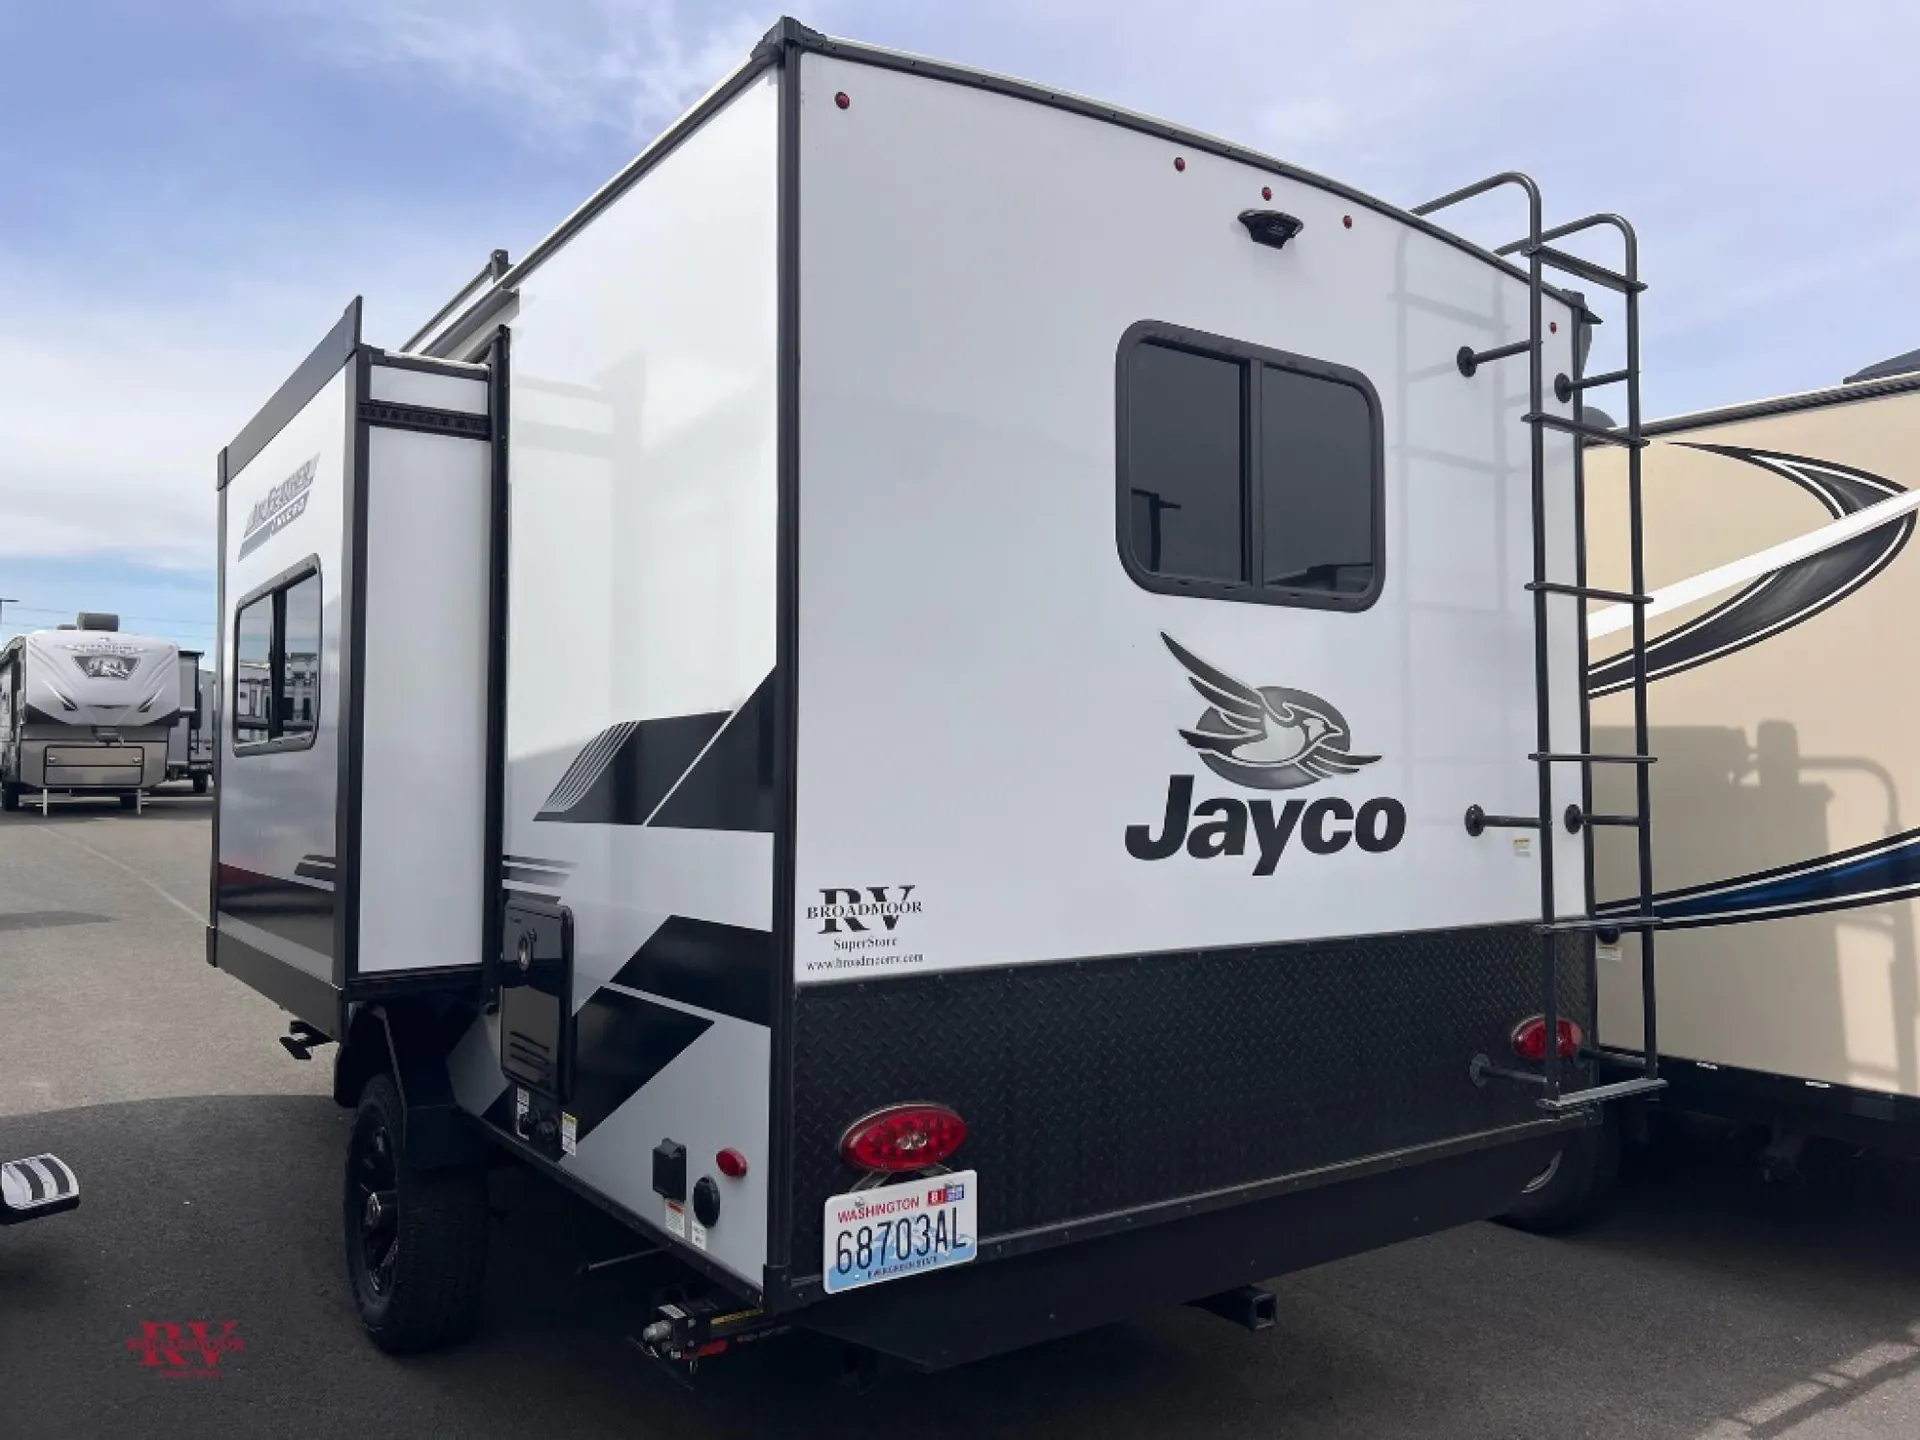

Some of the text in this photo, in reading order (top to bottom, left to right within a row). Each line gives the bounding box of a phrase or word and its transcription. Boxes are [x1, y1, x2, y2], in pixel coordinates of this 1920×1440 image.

[1125, 774, 1406, 876] Jayco
[806, 901, 922, 919] BROADMOOR
[817, 885, 915, 934] RV
[834, 936, 897, 953] SuperStore
[838, 1196, 919, 1223] WASHINGTON
[836, 1207, 966, 1275] 68703AL
